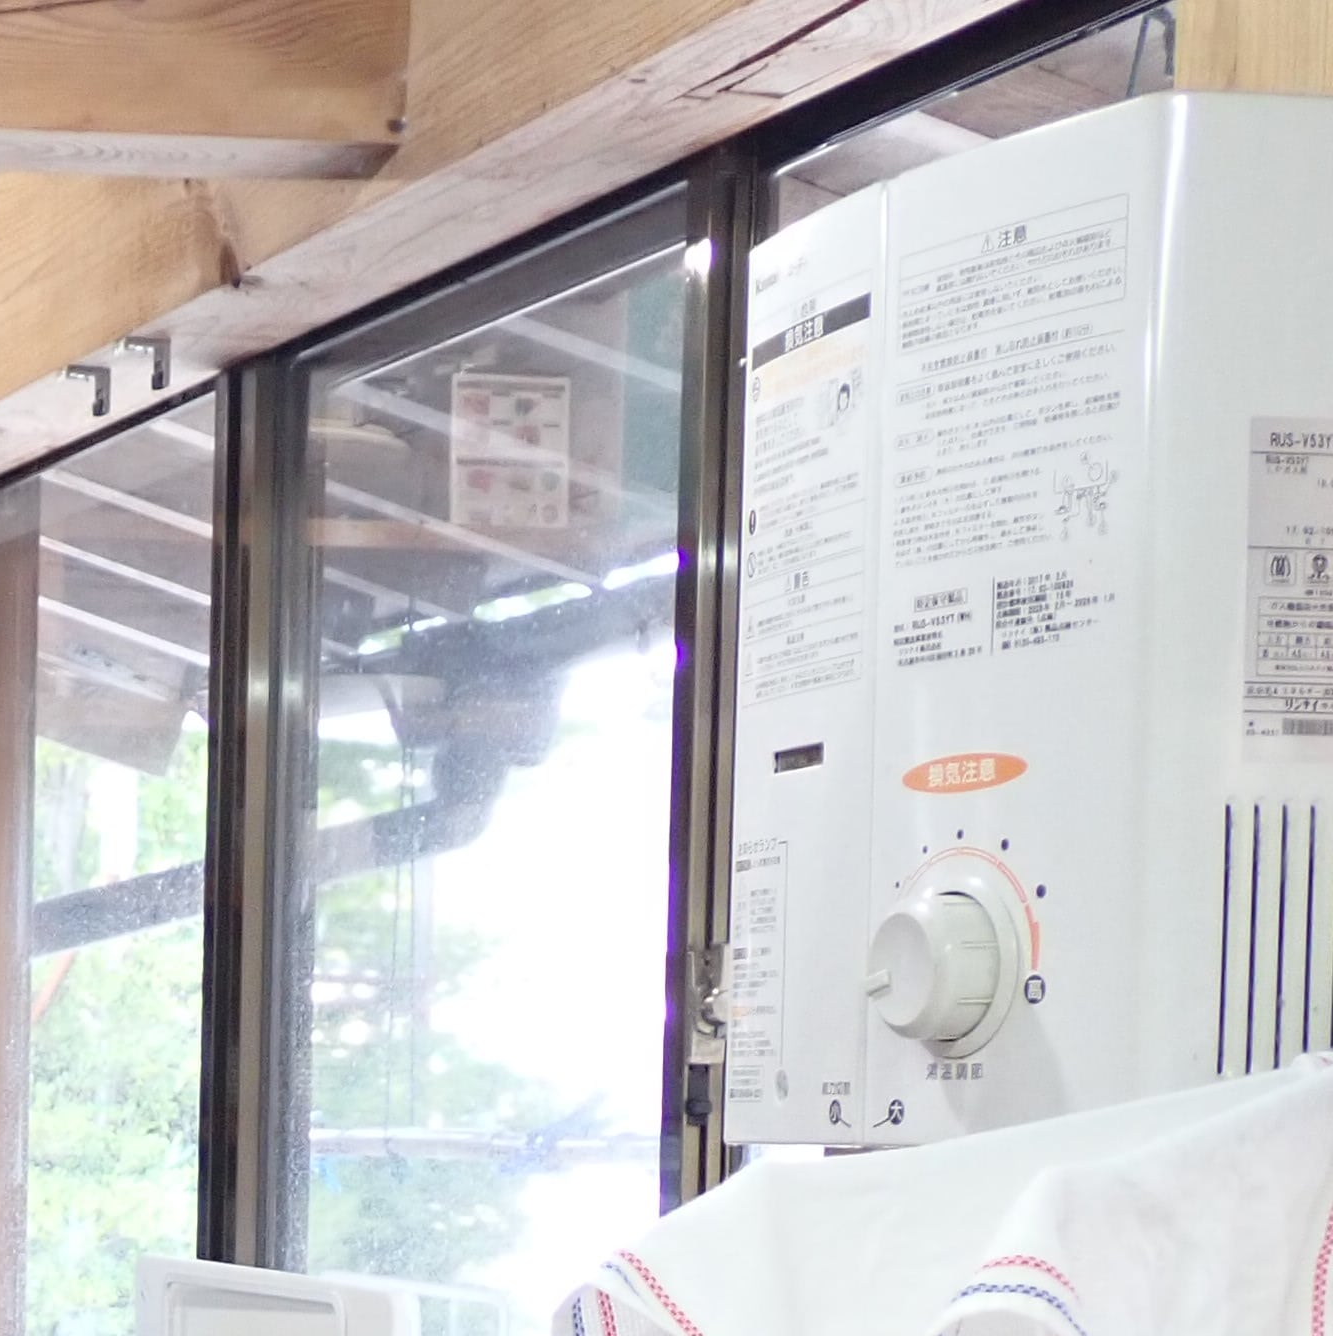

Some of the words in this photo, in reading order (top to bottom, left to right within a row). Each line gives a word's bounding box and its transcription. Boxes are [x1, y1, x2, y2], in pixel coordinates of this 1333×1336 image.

[997, 225, 1027, 248] 注意
[1270, 432, 1333, 448] RUS-V53Y
[928, 758, 996, 787] 換気注意
